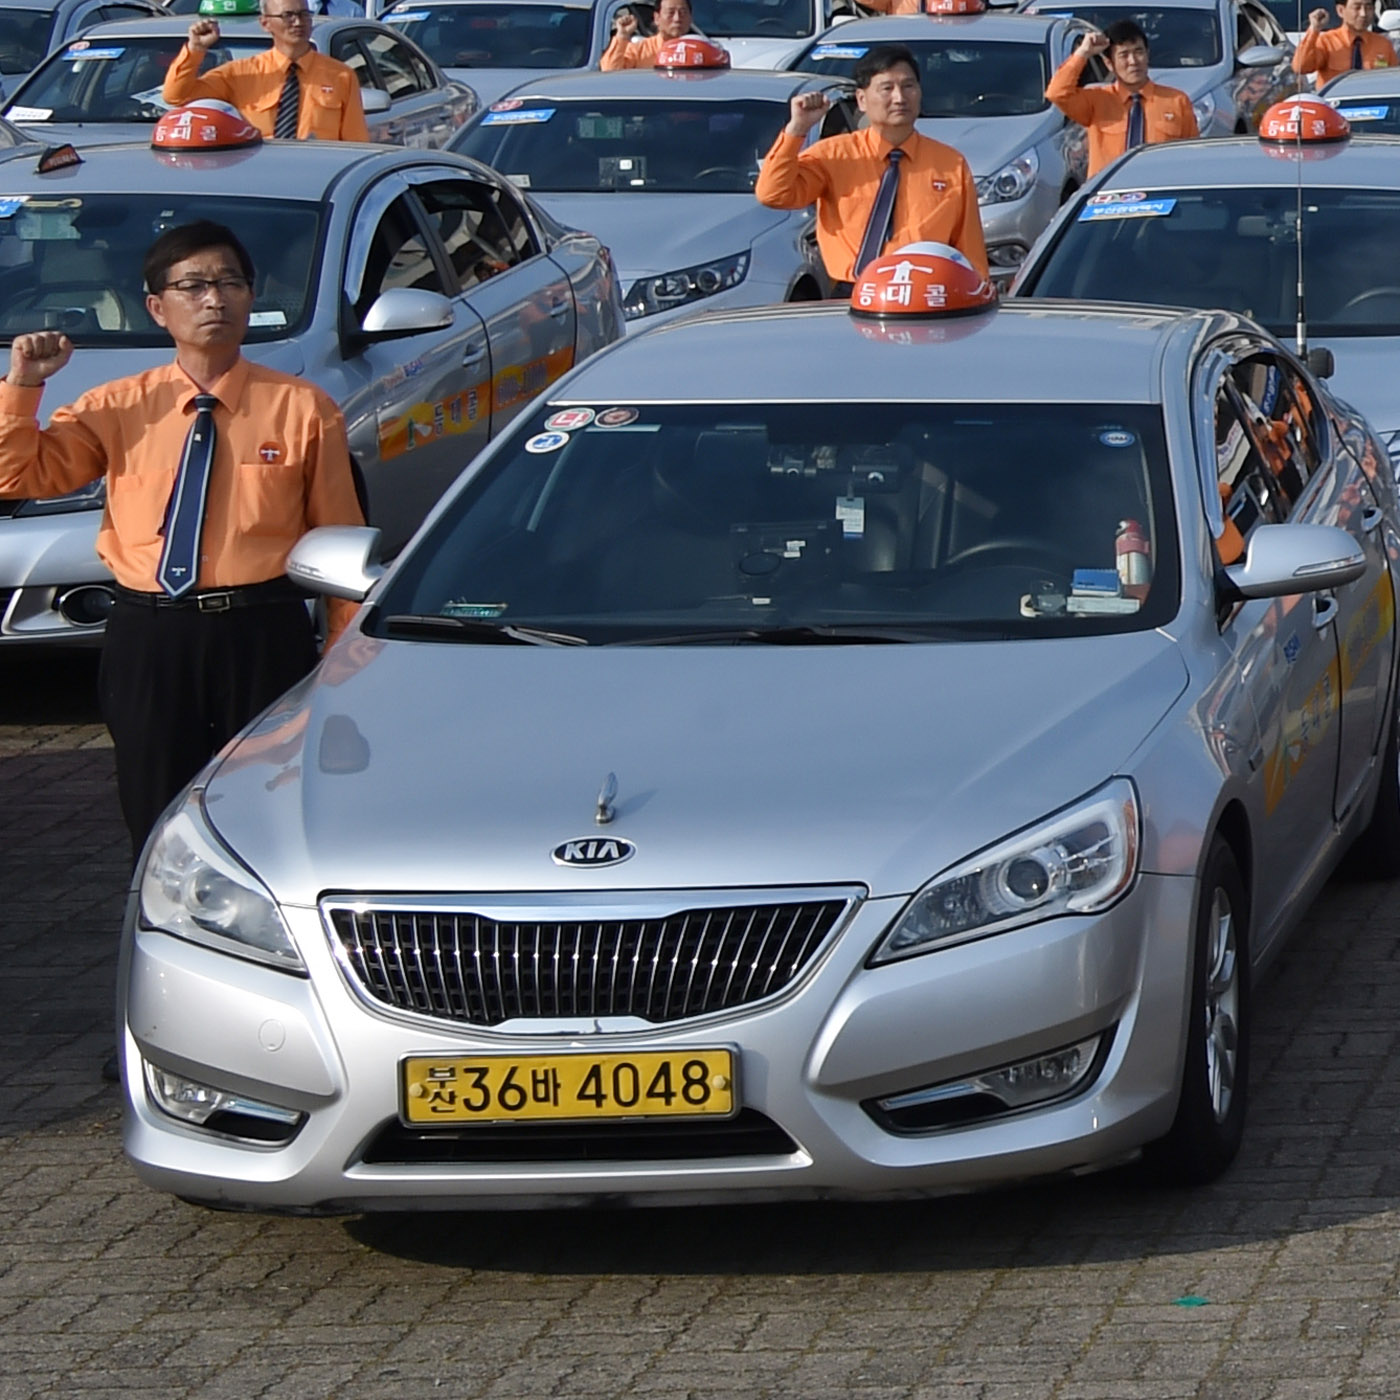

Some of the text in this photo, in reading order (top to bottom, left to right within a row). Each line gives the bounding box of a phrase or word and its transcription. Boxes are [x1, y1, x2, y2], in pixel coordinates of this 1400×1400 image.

[859, 283, 948, 308] 등대콜
[563, 841, 620, 860] KIA
[426, 1059, 712, 1113] 부산 36바 4048
